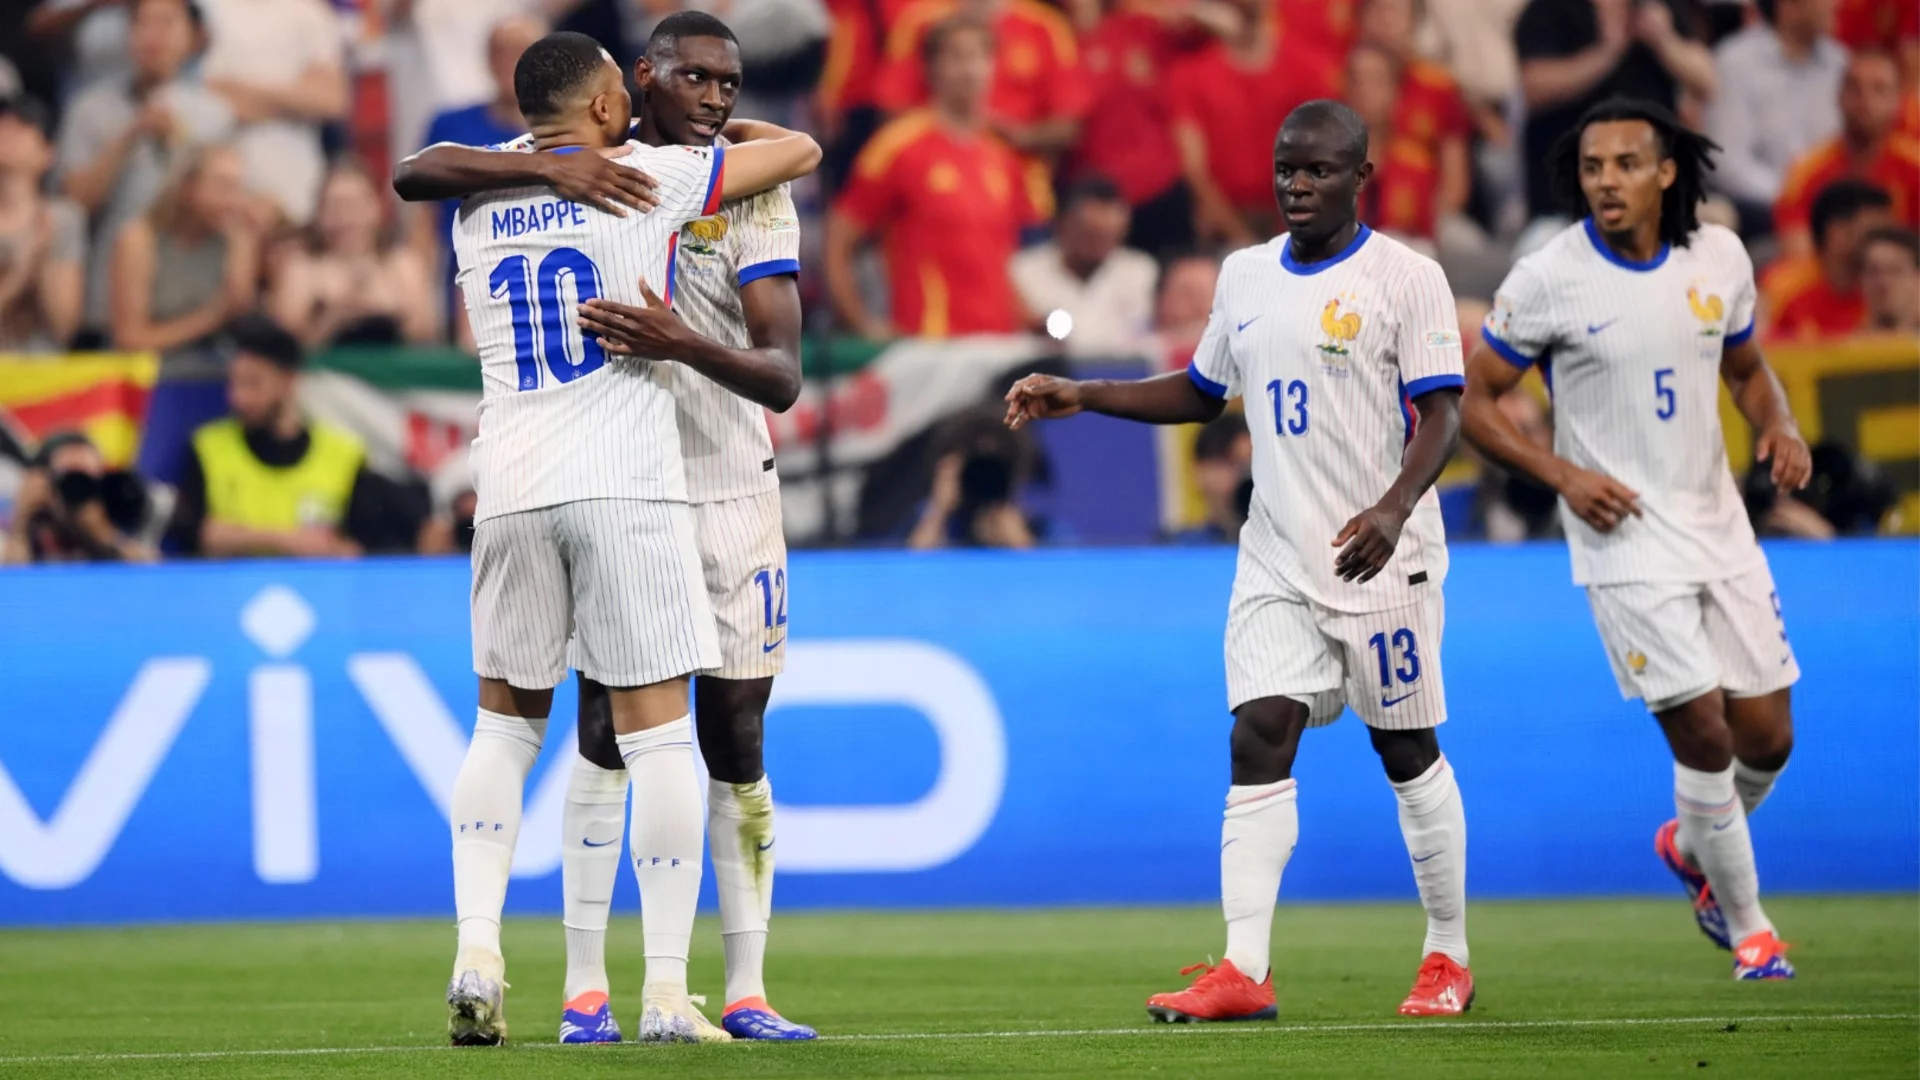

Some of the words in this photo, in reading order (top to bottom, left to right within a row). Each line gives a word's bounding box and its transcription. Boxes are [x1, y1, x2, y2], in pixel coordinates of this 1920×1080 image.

[489, 246, 611, 392] 10
[1266, 379, 1310, 438] 13
[1654, 367, 1677, 421] 5
[754, 567, 787, 630] 12
[1368, 627, 1422, 689] 13
